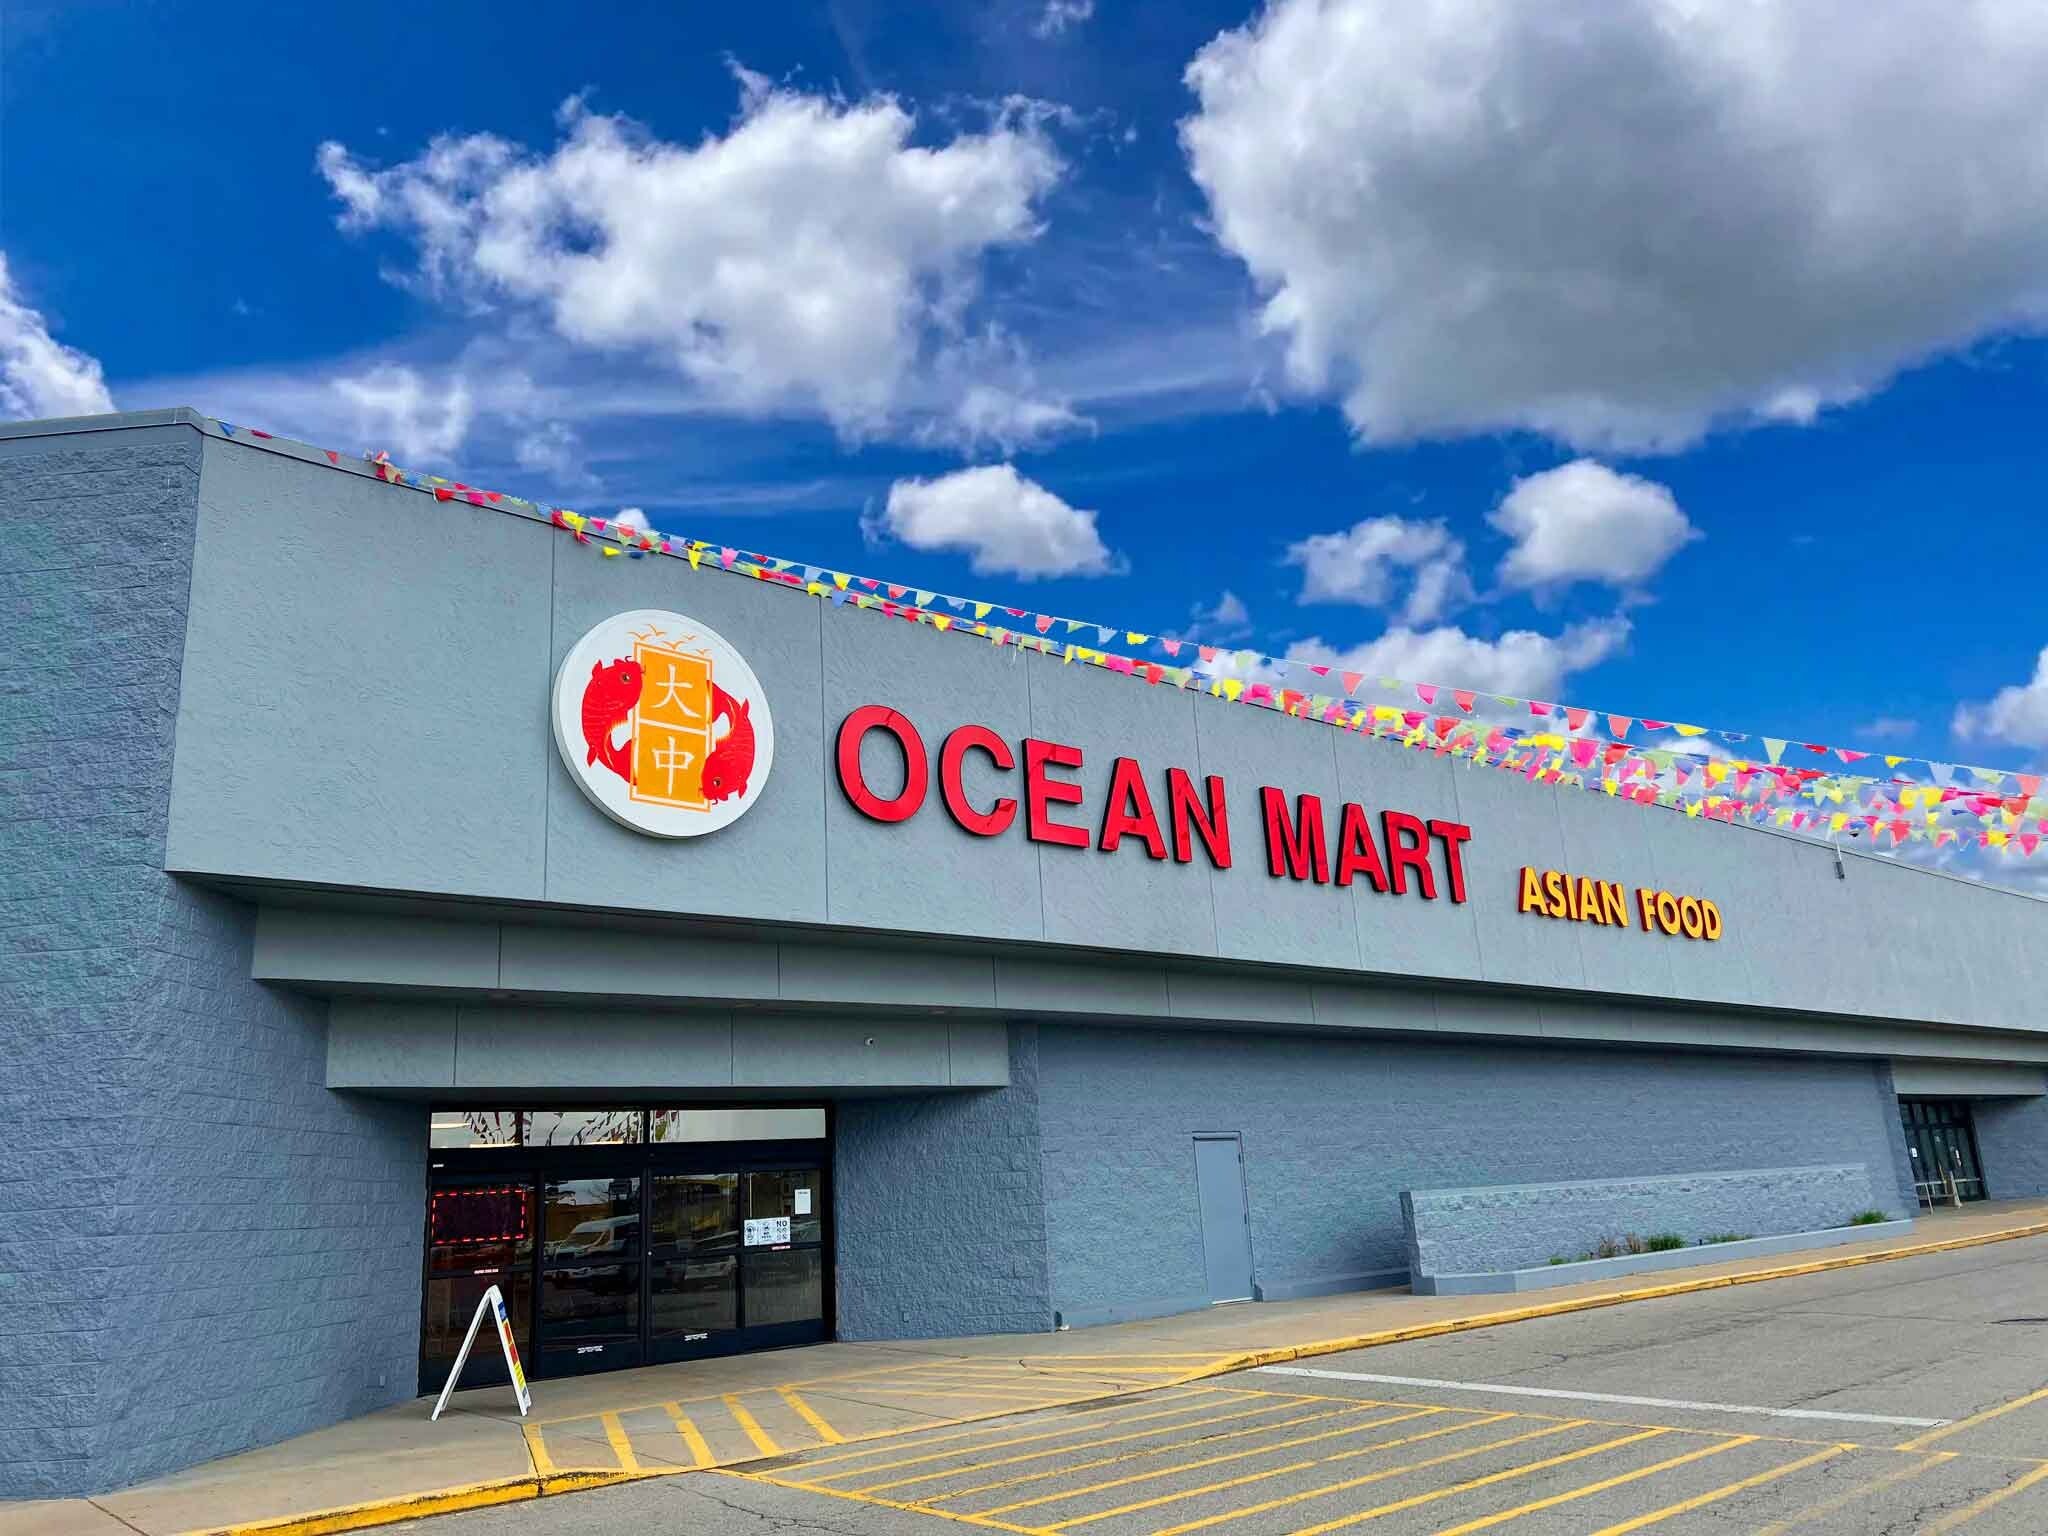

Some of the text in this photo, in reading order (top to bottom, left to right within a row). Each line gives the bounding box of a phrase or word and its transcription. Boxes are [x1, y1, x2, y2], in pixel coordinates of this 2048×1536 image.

[651, 663, 703, 797] 大中
[834, 704, 1471, 904] OCEAN MART
[1518, 865, 1723, 941] ASIAN FOOD
